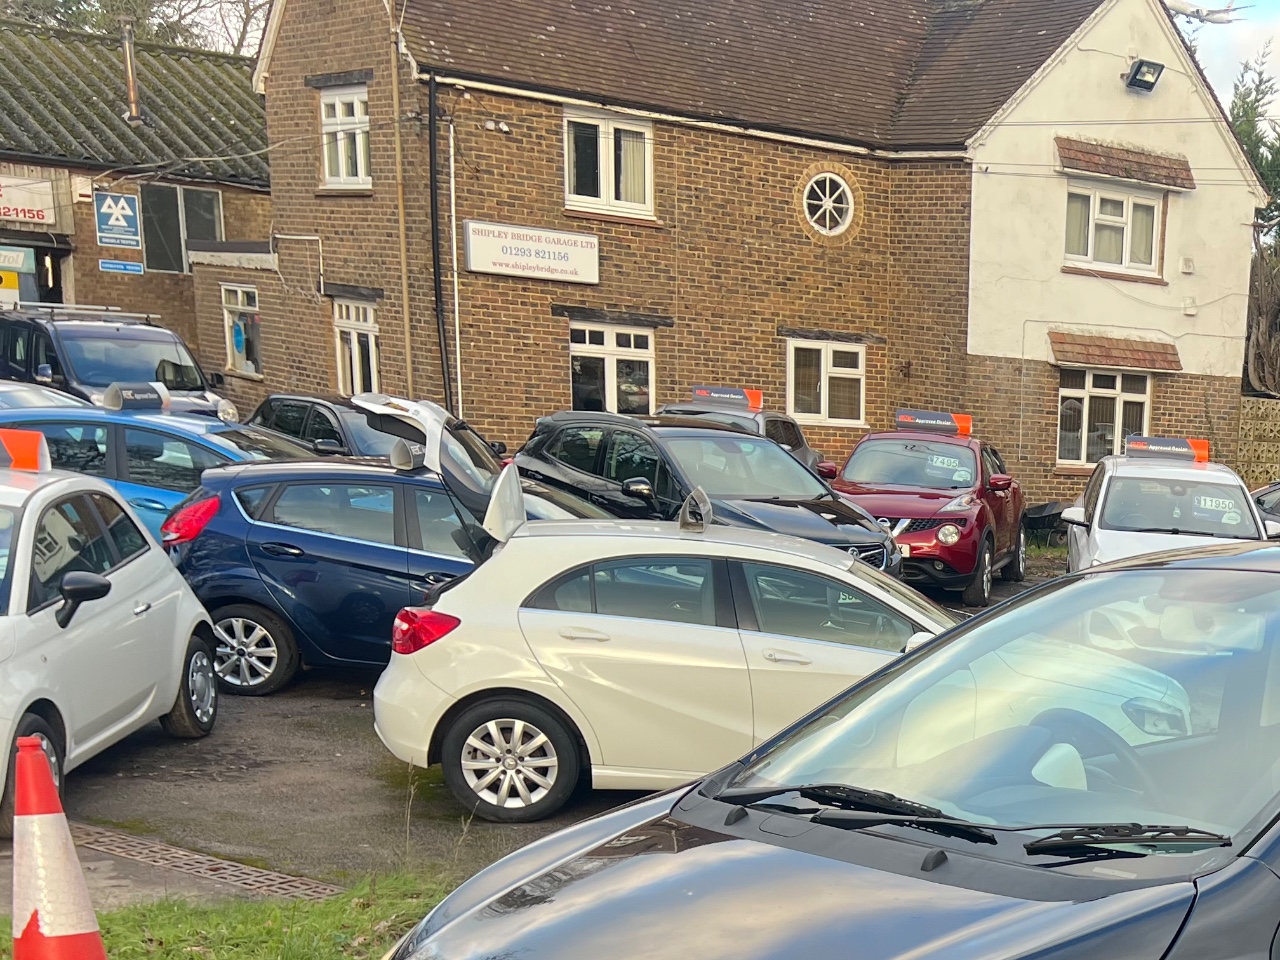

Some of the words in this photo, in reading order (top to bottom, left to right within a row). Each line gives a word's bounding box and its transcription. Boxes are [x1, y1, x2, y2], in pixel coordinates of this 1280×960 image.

[0, 206, 45, 220] 21156
[471, 228, 509, 240] SHIPLEY
[511, 233, 543, 244] BRIDGE
[544, 236, 579, 247] GARAGE
[580, 240, 596, 250] LTD
[501, 245, 532, 258] 01293
[534, 249, 569, 262] 821156
[491, 260, 579, 276] www.shipleybridge.co.uk
